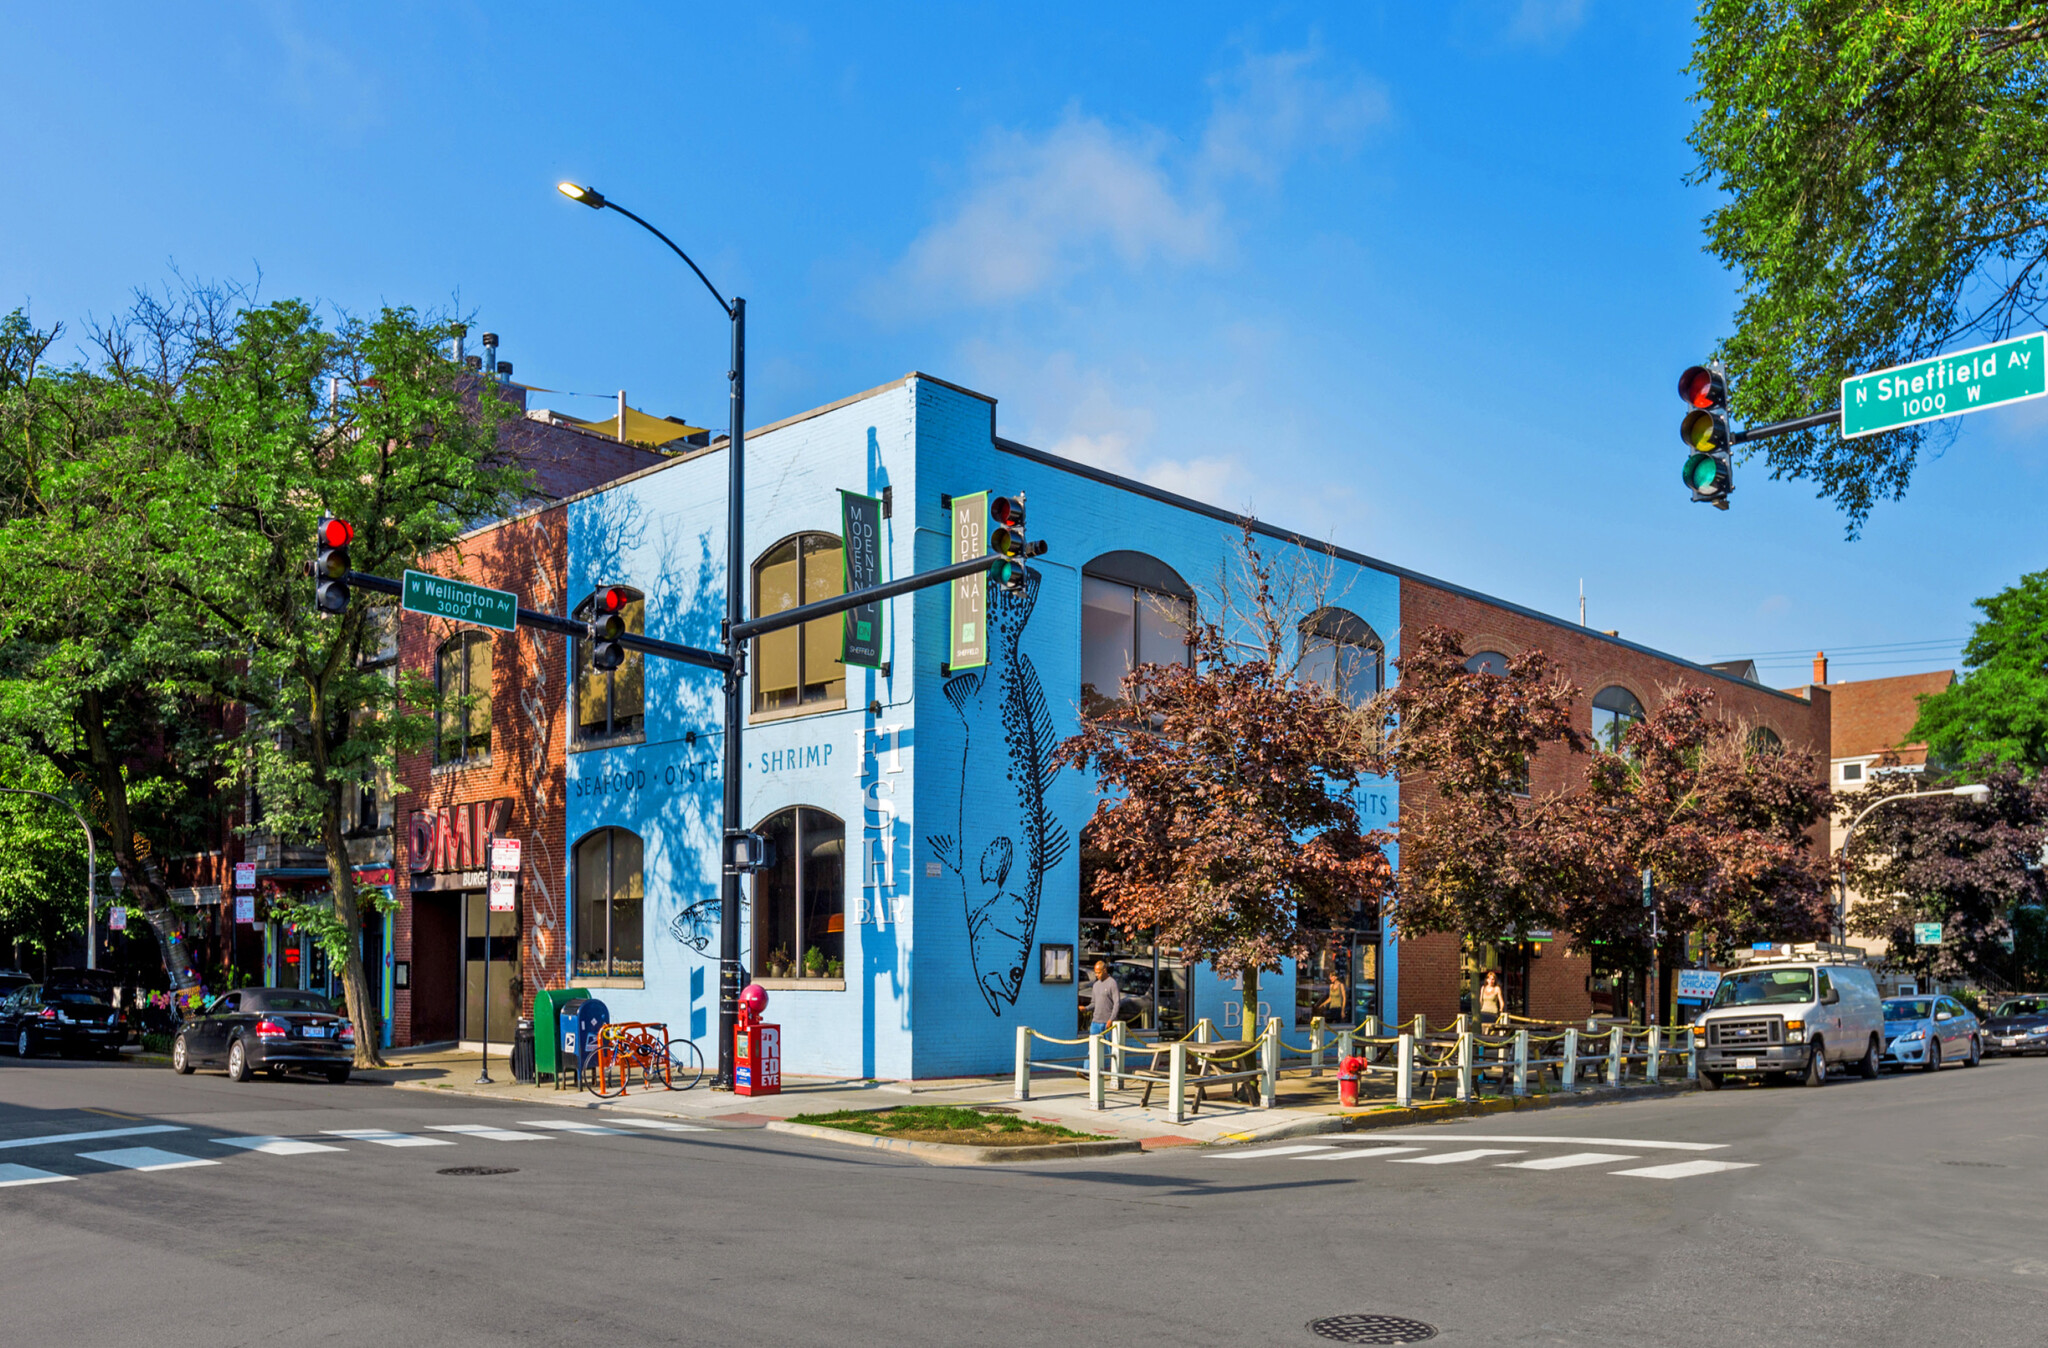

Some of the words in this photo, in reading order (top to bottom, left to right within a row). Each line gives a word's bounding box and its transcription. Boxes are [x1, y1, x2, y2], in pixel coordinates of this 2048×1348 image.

[1856, 386, 1867, 404] N
[1878, 353, 1996, 401] Sheffield
[2007, 351, 2031, 368] Av
[1903, 393, 1946, 417] 1000
[1967, 384, 1981, 403] W
[411, 580, 420, 592] W
[425, 580, 494, 608] Wellington
[497, 600, 510, 613] Av
[437, 600, 468, 616] 3000
[475, 608, 483, 619] N
[576, 770, 647, 798] SEAFOOD
[664, 759, 726, 787] OYSTE
[760, 743, 834, 774] SHRIMP
[409, 800, 504, 873] DMK
[852, 897, 906, 926] BAR
[1681, 979, 1718, 990] CHICAGO
[1223, 1001, 1272, 1028] BR
[761, 1075, 779, 1087] EYE
